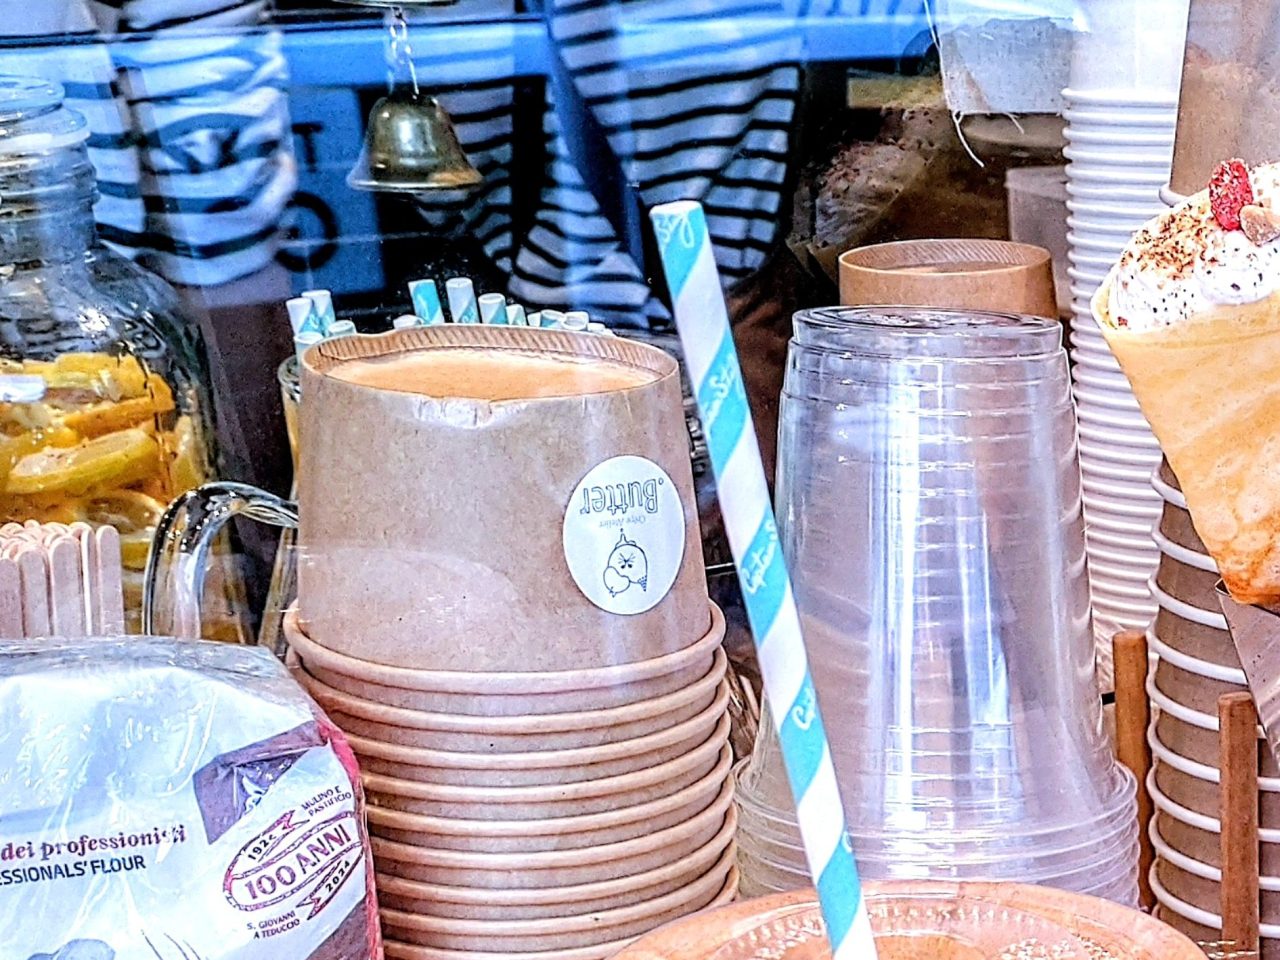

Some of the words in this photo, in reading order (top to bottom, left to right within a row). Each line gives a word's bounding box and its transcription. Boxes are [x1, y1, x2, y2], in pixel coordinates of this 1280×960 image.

[308, 792, 352, 816] PASTIFICIO
[1, 841, 35, 861] dei
[91, 855, 147, 875] FLOUR
[245, 865, 297, 900] 100
[295, 824, 352, 875] ANNI
[325, 860, 350, 893] 2024
[253, 931, 260, 939] A
[262, 919, 300, 938] TEDUCCIO
[258, 910, 296, 930] GIOVANNI
